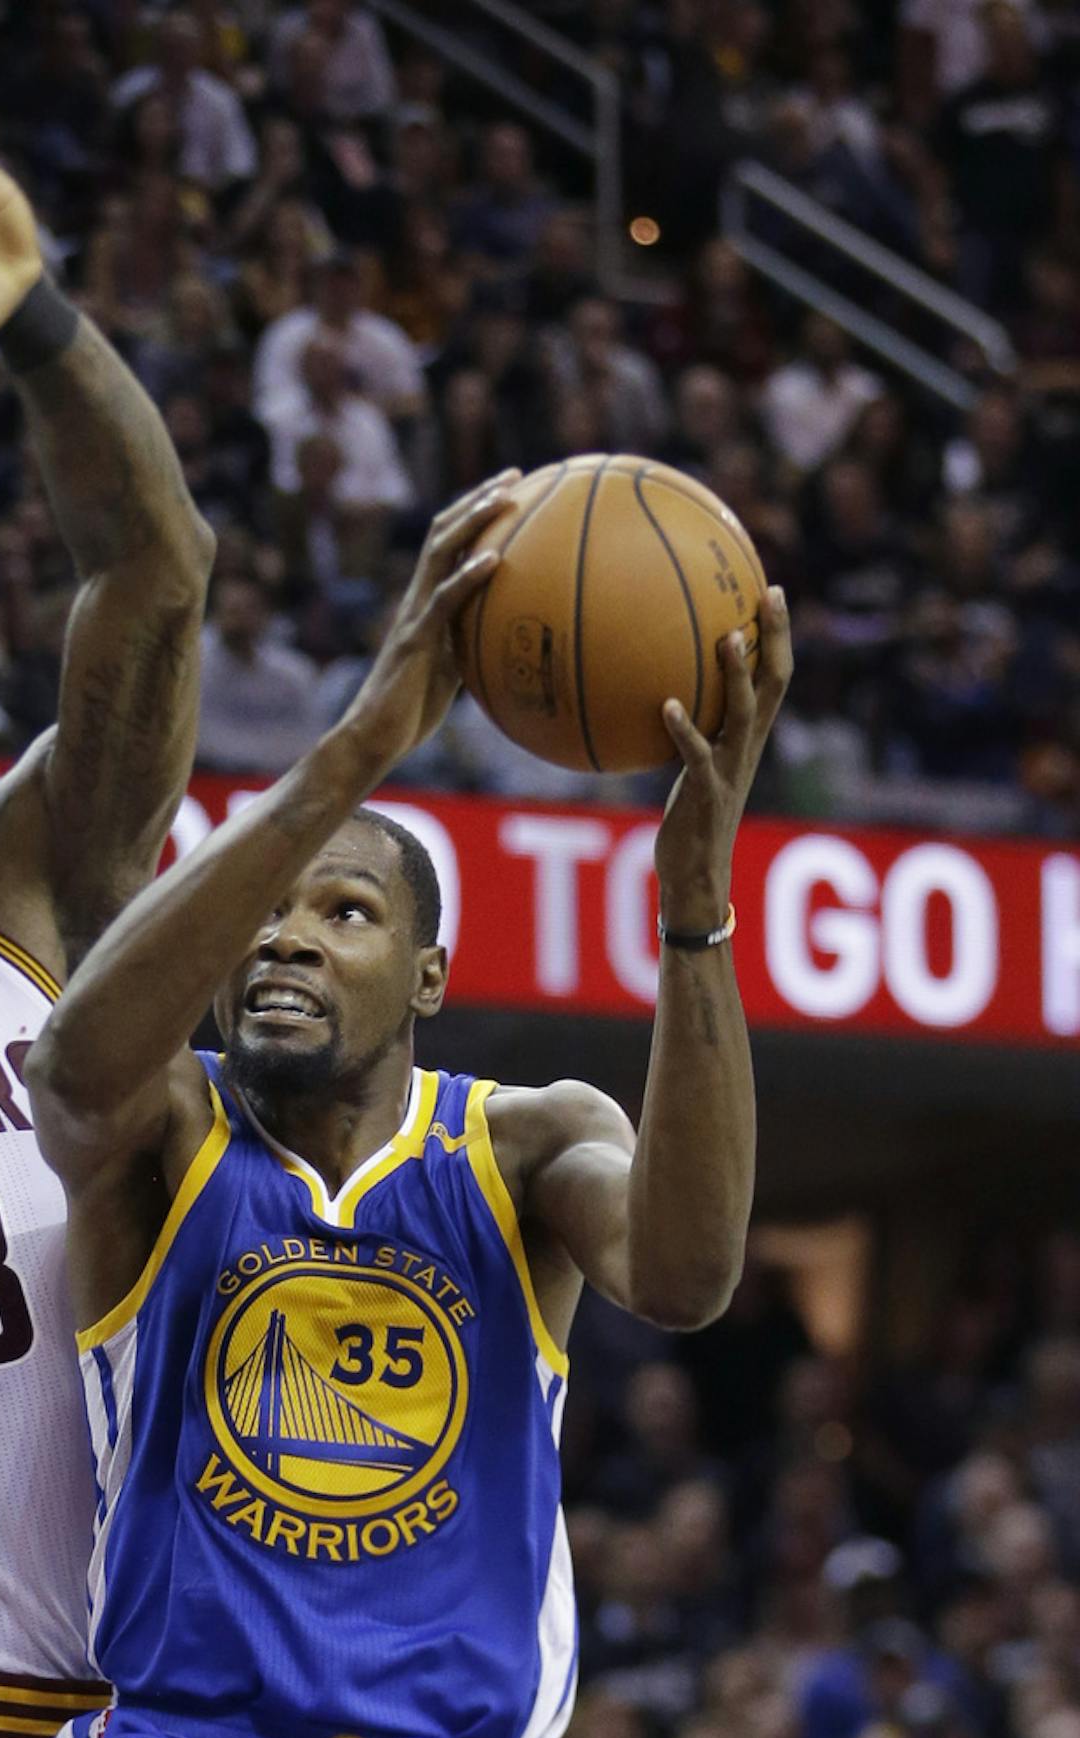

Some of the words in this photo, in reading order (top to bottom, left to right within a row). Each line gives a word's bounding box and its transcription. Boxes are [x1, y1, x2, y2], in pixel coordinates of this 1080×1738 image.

[764, 832, 1000, 1028] GO
[216, 1238, 359, 1297] GOLDEN
[374, 1246, 475, 1327] STATE
[330, 1323, 426, 1389] 35
[196, 1453, 460, 1562] WARRIORS
